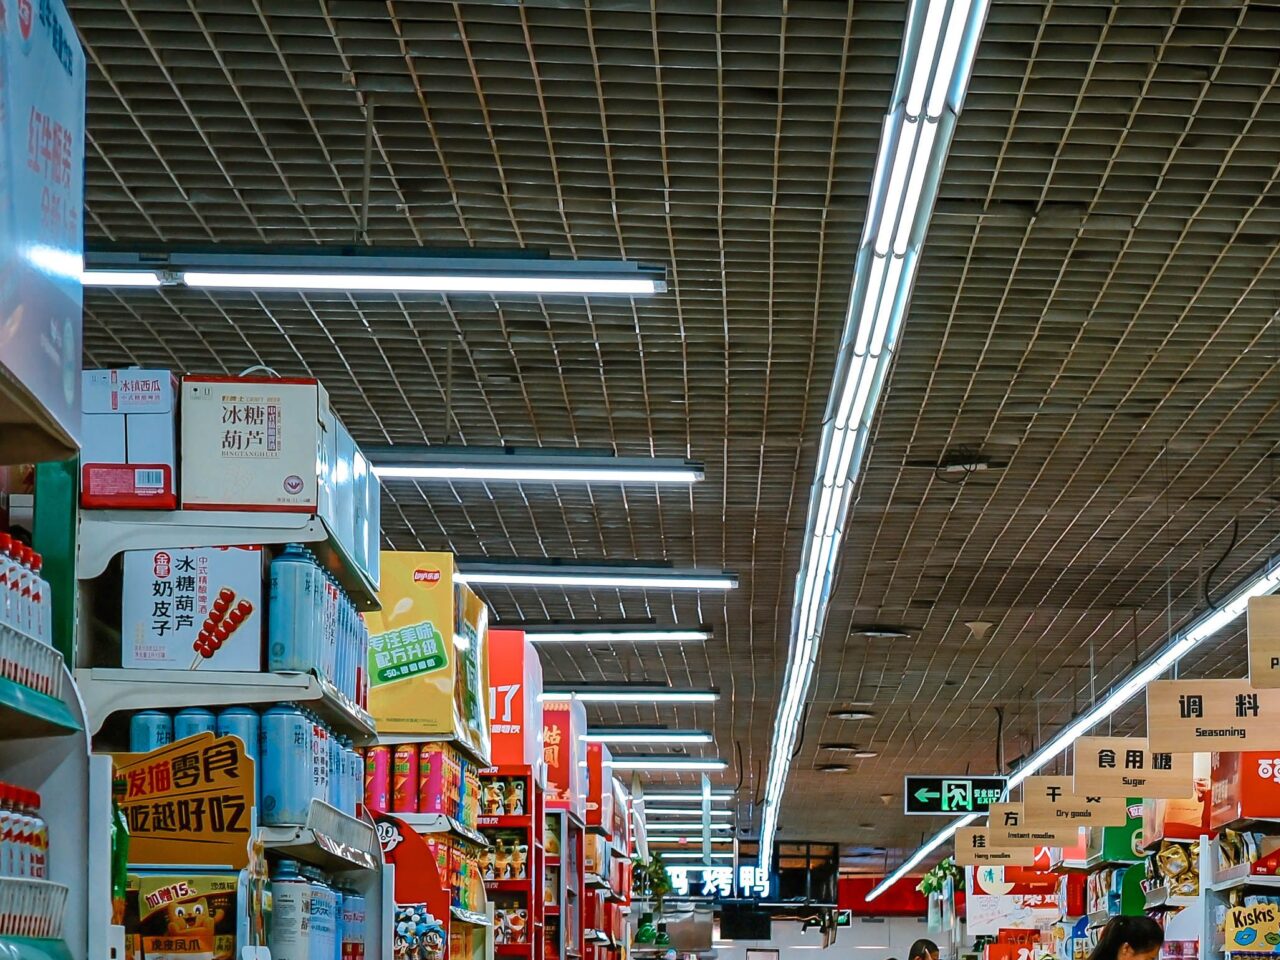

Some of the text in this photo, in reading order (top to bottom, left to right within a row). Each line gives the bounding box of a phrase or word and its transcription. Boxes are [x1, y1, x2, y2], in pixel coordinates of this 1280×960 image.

[120, 379, 161, 392] 冰镇西瓜
[222, 404, 265, 425] 冰糖
[221, 430, 265, 451] 葫芦
[153, 552, 171, 578] 金星
[175, 556, 196, 632] 冰糖葫芦
[152, 580, 173, 637] 奶皮子
[369, 624, 434, 652] 专注美味
[375, 640, 438, 669] 配方升级
[1179, 694, 1260, 718] 调料
[1195, 727, 1246, 739] Seasoning
[114, 740, 241, 798] 发猫零食
[1098, 750, 1172, 770] 食用糖
[974, 788, 1001, 797] 安全出口
[1122, 777, 1147, 787] Sugar
[123, 795, 249, 833] 吃越好吃
[1004, 812, 1018, 826] 方
[1056, 810, 1092, 819] Dry goods
[973, 834, 986, 848] 挂
[1232, 909, 1275, 929] Kiskis
